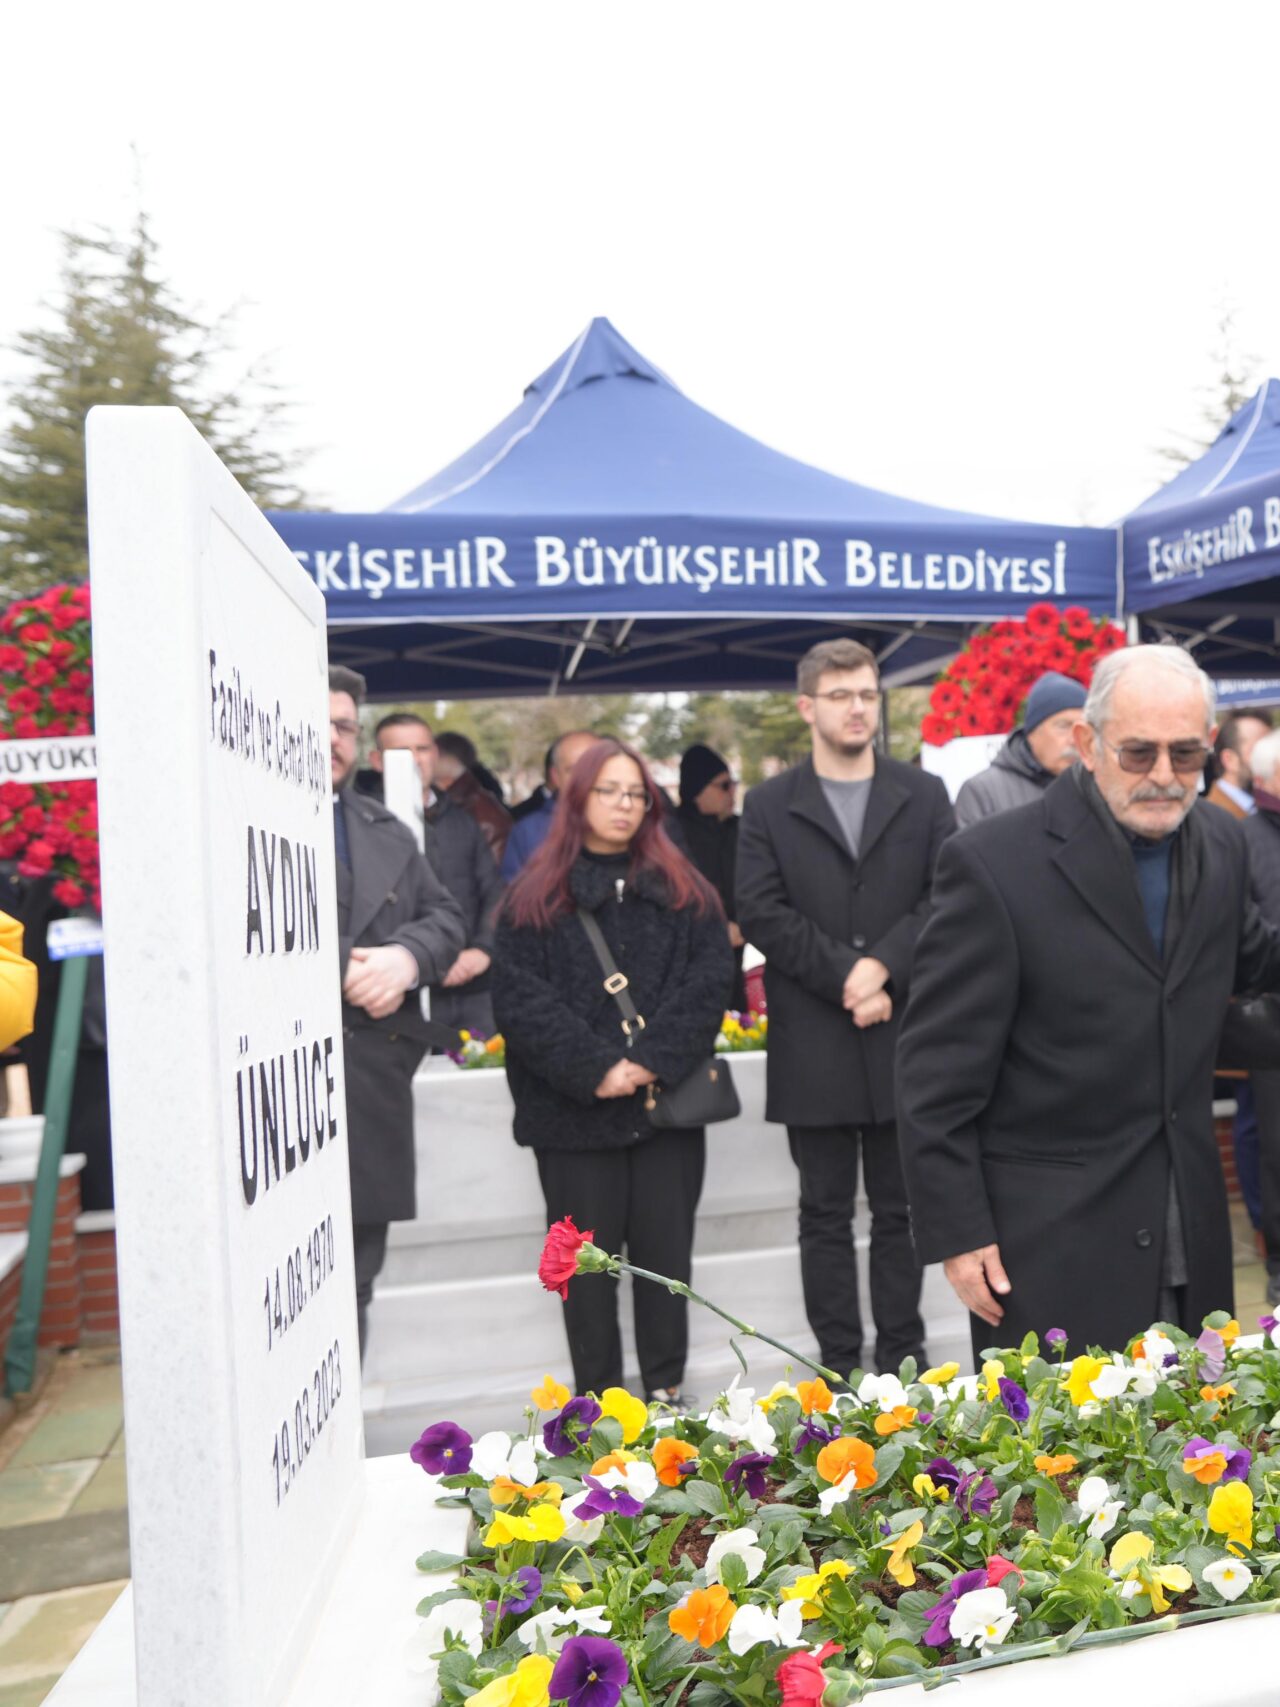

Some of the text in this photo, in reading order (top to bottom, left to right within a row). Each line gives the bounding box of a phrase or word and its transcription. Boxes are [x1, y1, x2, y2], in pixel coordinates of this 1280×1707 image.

[292, 535, 1067, 599] KİŞEHİR BÜYÜKŞEHİR BELEDİYESİ
[1149, 507, 1256, 584] ESKİŞEHİR
[0, 743, 97, 774] ÜYÜK
[209, 648, 256, 761] Fazilet
[258, 707, 272, 769] ve
[275, 699, 305, 784] Cemal
[246, 825, 320, 954] AYDIN
[236, 1020, 338, 1206] ÜNLÜCE
[264, 1213, 335, 1352] 14.08.1970
[271, 1339, 343, 1508] 19.03.2023
